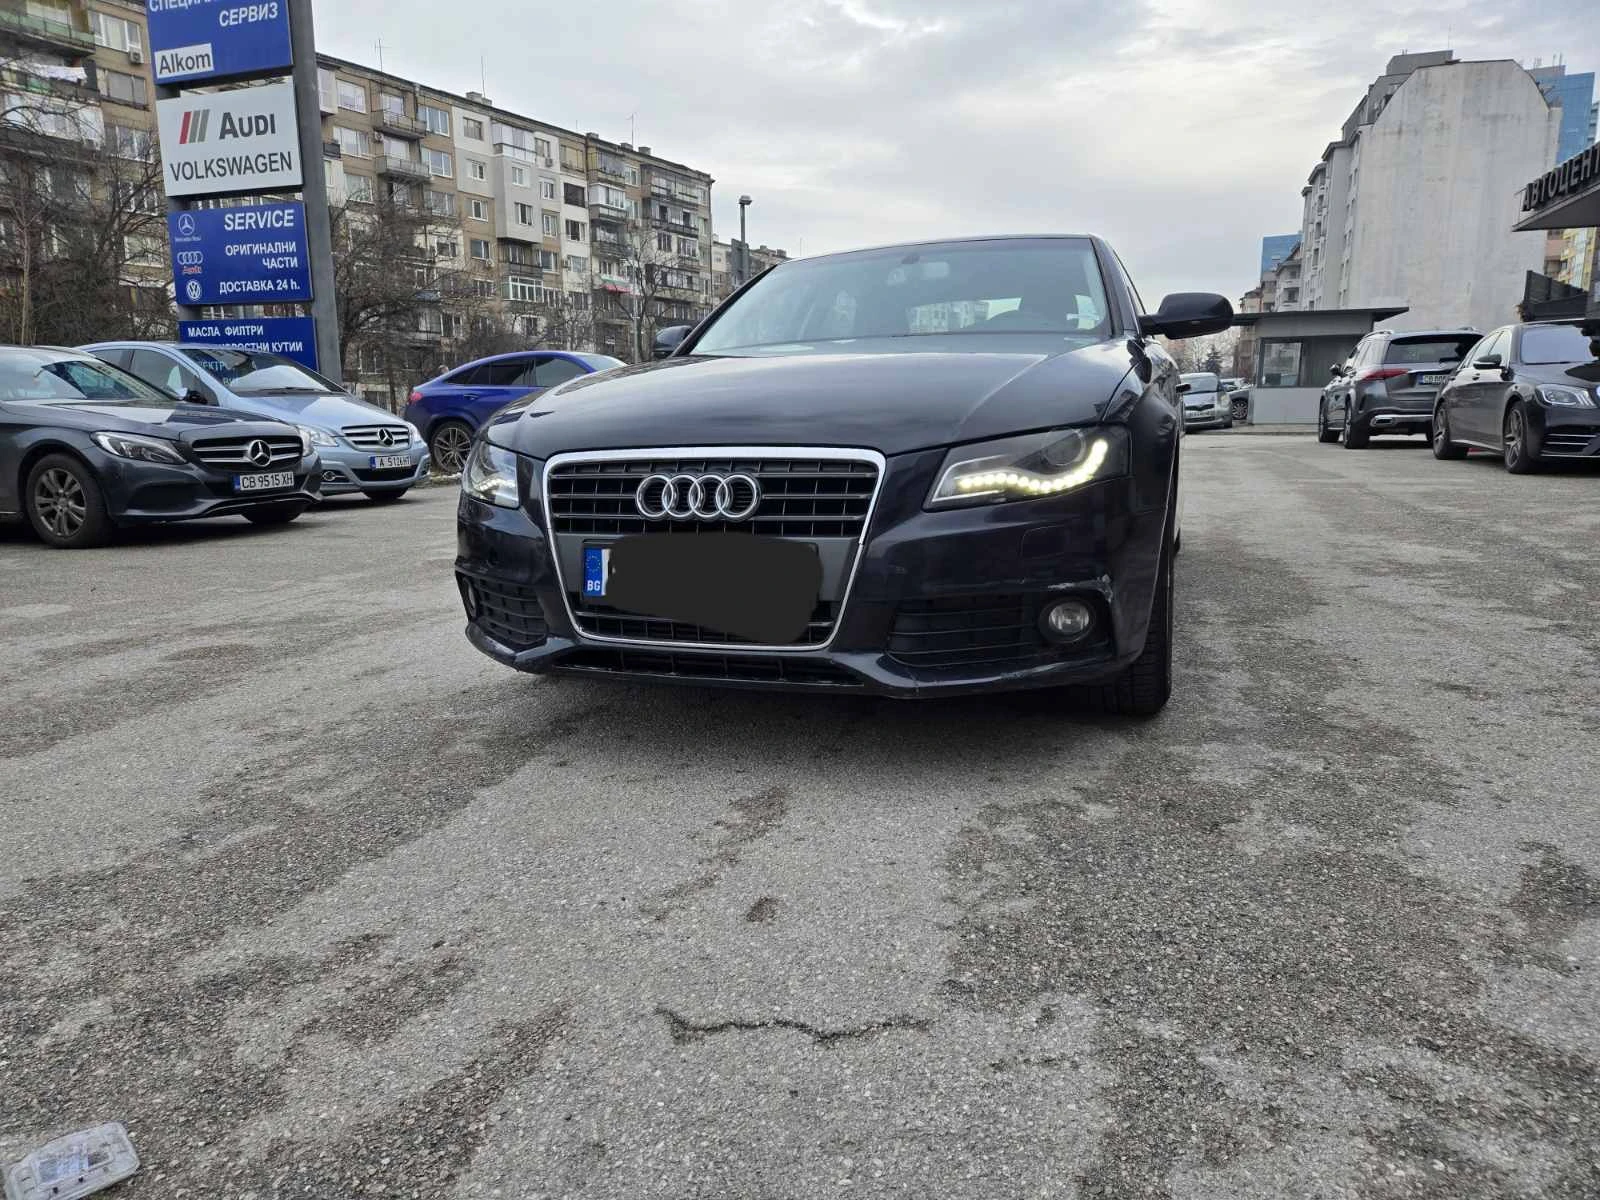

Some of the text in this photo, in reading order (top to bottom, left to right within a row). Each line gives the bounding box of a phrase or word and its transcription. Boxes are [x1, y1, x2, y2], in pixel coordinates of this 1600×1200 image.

[219, 3, 279, 28] СЕРВИЗ
[159, 52, 211, 75] Alkom
[170, 151, 293, 182] VOLKSWAGEN
[224, 209, 295, 231] SERVICE
[225, 241, 297, 257] ОРИГИНАЛНИ
[262, 257, 299, 270] ЧАСТИ
[219, 280, 274, 295] ДОСТАВКА
[276, 279, 289, 291] 24
[187, 324, 264, 338] МАСЛА ФИЛТРИ
[271, 341, 303, 353] КУТИИ
[257, 474, 281, 488] 9515
[587, 580, 601, 591] BG
